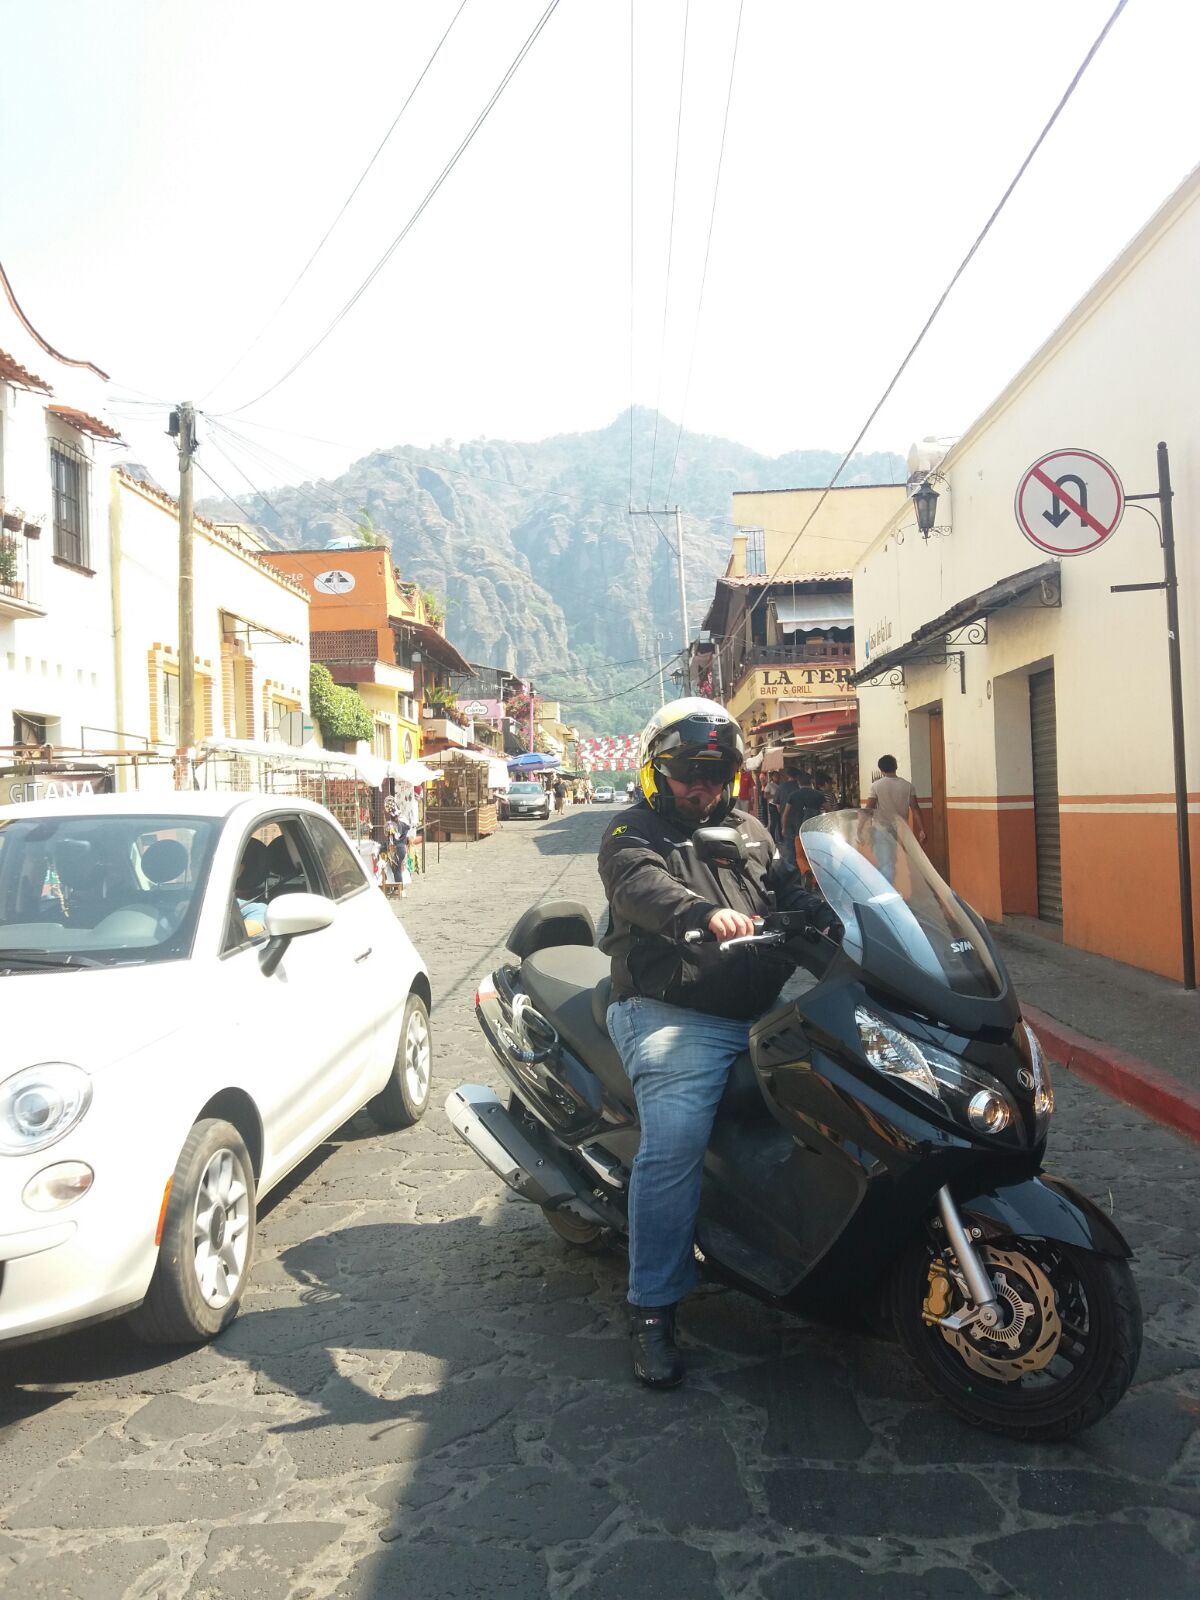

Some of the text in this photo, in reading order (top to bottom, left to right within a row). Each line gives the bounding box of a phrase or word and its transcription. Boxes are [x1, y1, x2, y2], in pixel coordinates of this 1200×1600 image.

[763, 668, 856, 686] LA TER
[760, 684, 856, 695] BAR & GRILL YE
[10, 780, 95, 804] GITANA
[950, 940, 975, 953] SYM
